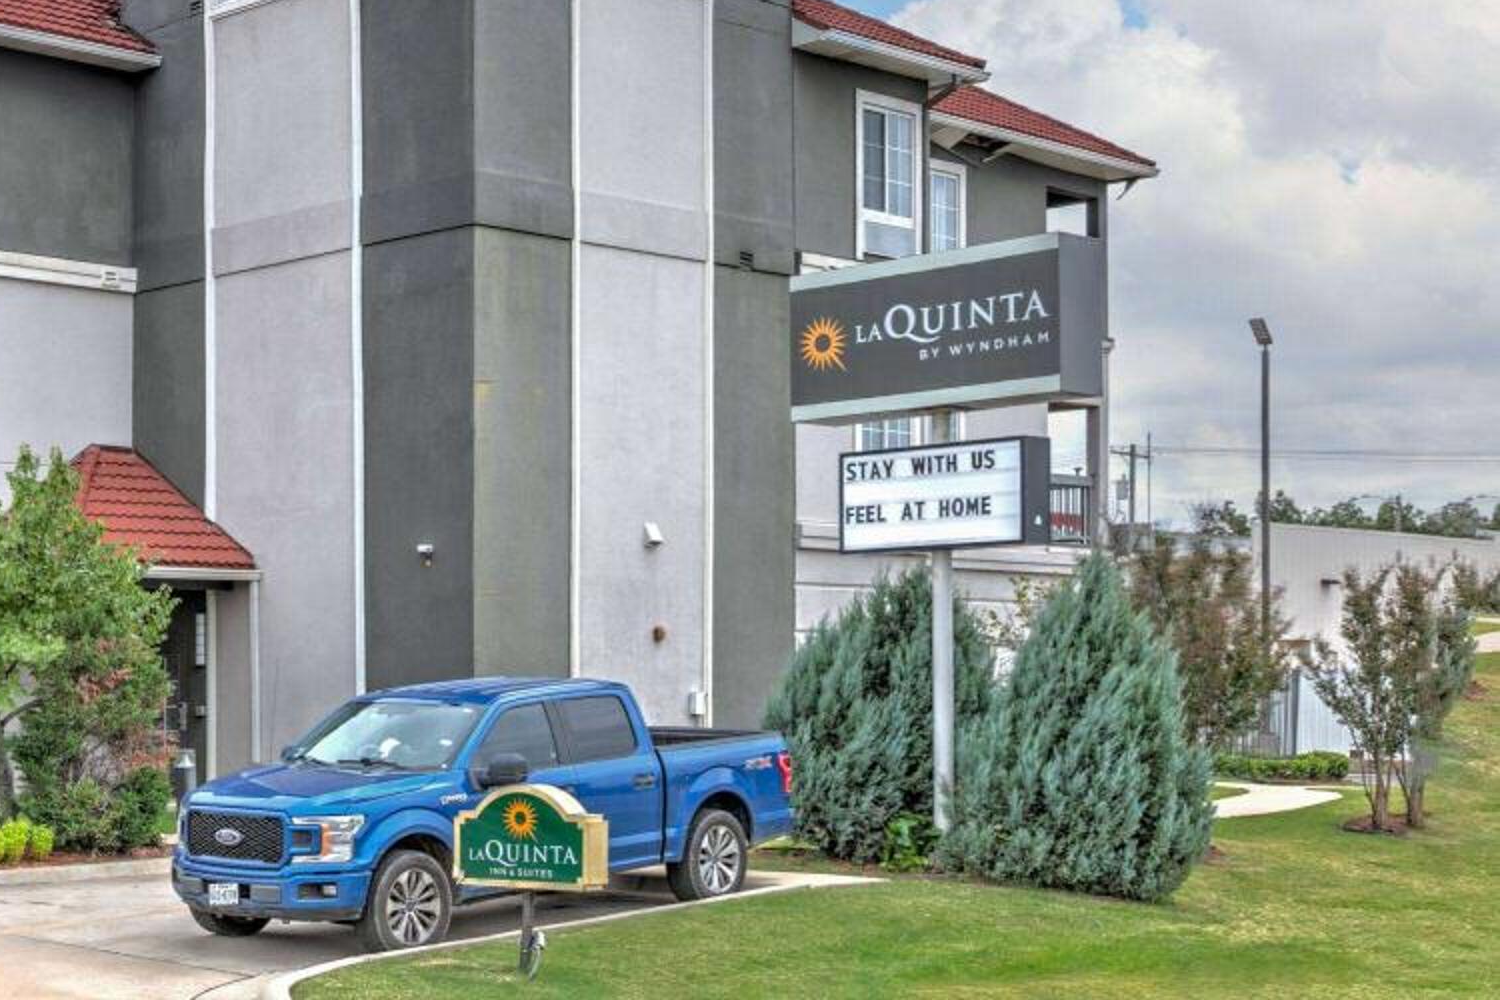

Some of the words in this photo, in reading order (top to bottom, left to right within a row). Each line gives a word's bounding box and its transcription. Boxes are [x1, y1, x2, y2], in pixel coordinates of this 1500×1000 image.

[855, 323, 883, 344] LA
[883, 289, 1050, 343] QUINTA
[919, 347, 940, 361] BY
[949, 331, 1050, 356] WYNDHAM
[846, 458, 895, 481] STAY
[911, 453, 958, 476] WITH
[971, 450, 996, 470] US
[845, 503, 887, 524] FEEL
[901, 501, 926, 521] AT
[939, 495, 992, 519] HOME
[469, 847, 485, 861] LA
[485, 839, 578, 867] QUINTA
[489, 867, 507, 876] INN
[517, 867, 553, 879] SUITES
